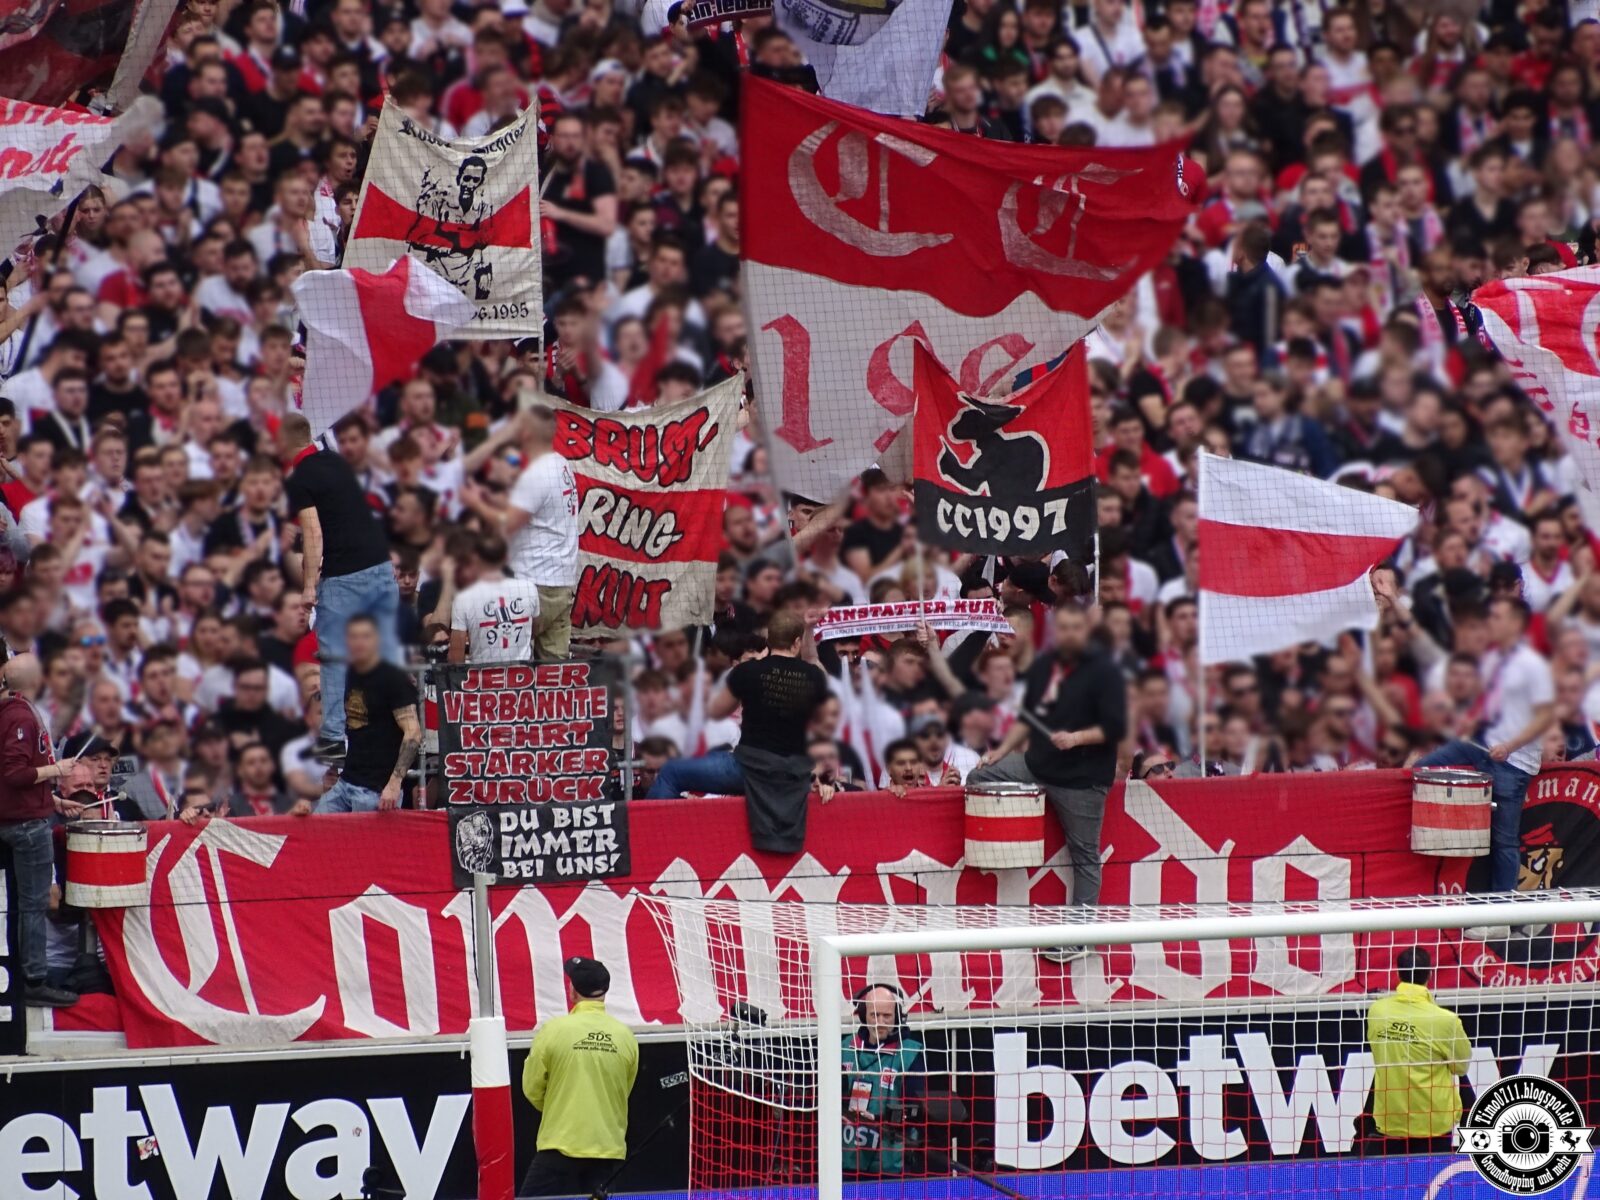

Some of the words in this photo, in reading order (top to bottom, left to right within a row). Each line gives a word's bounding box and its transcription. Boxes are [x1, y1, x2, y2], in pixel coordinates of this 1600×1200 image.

[471, 302, 530, 320] 6.1995
[937, 497, 1069, 542] CC1997
[569, 562, 672, 630] KULT
[819, 602, 947, 627] NNSTATTER
[953, 599, 998, 616] KUR
[461, 663, 591, 691] JEDER
[443, 686, 608, 724] VERBANNTE
[461, 719, 594, 749] KEHRT
[448, 775, 606, 804] ZURÜCK
[499, 809, 540, 832] DU
[552, 803, 615, 828] BIST
[500, 828, 619, 858] IMMER
[502, 859, 545, 878] BEI
[556, 853, 622, 876] UNS!
[587, 1032, 612, 1042] SDS
[994, 1032, 1560, 1170] betw
[0, 1083, 472, 1200] etway
[842, 1125, 880, 1150] OST
